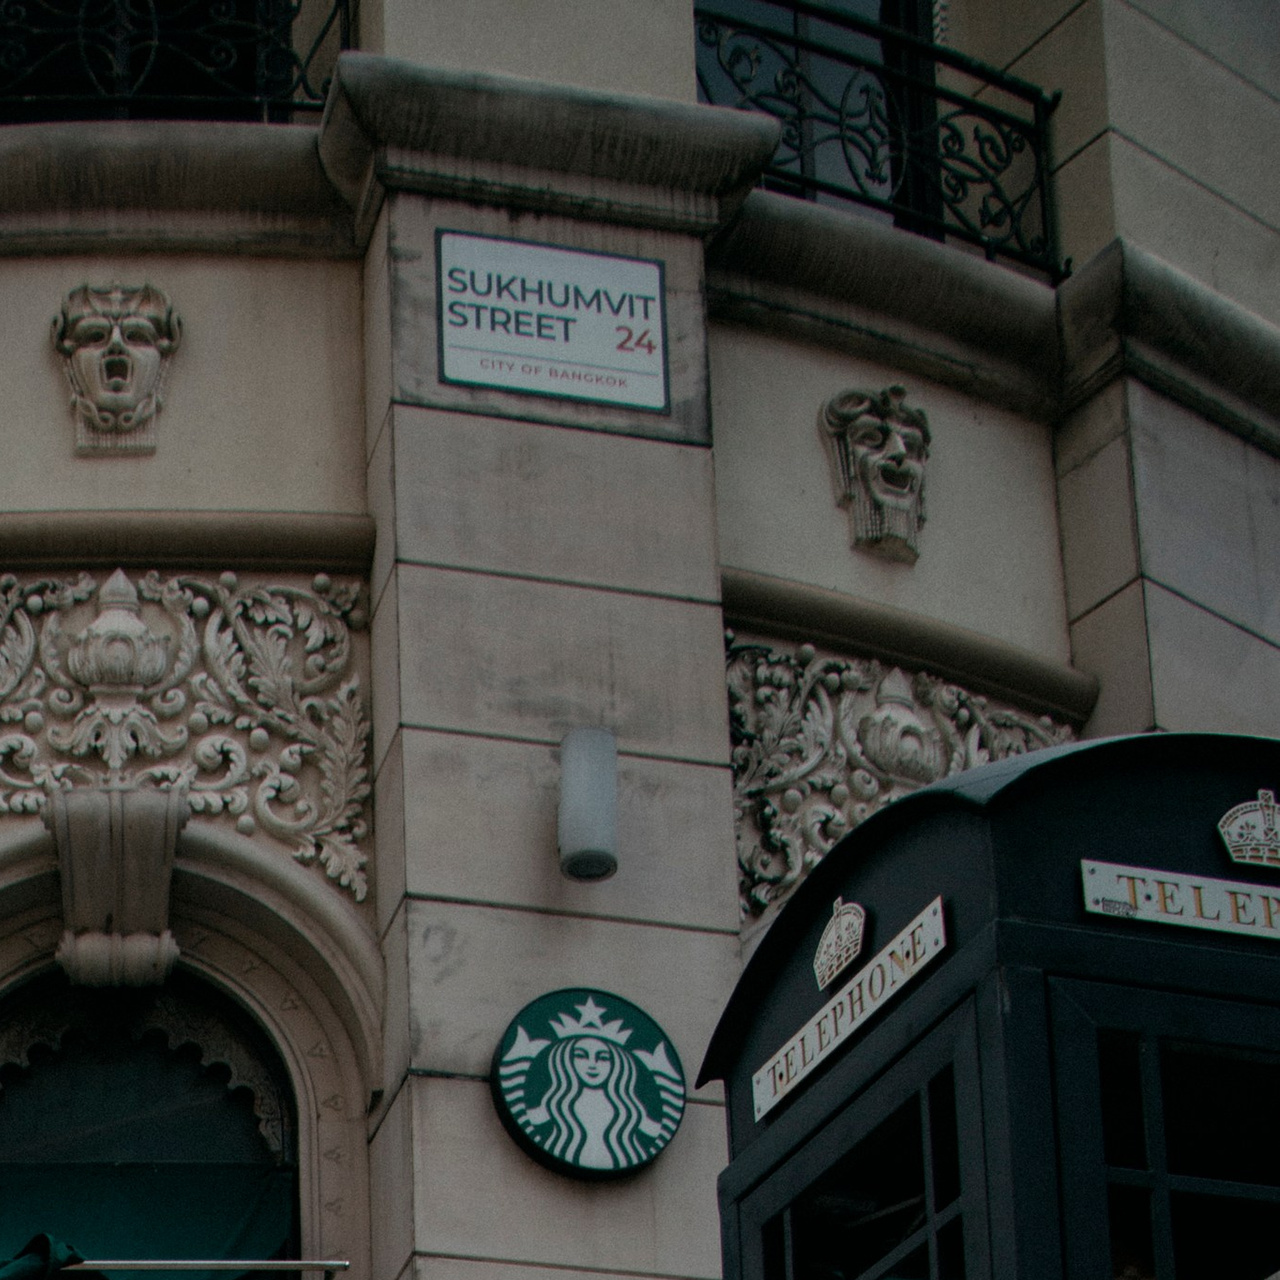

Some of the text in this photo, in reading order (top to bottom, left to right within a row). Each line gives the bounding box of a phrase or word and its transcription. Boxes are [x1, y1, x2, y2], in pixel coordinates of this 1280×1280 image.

[447, 267, 656, 321] SUKHUMVIT
[448, 300, 656, 355] STREET 24
[480, 358, 628, 389] CITY OF BANGKOK
[767, 923, 926, 1098] TELEPHONE
